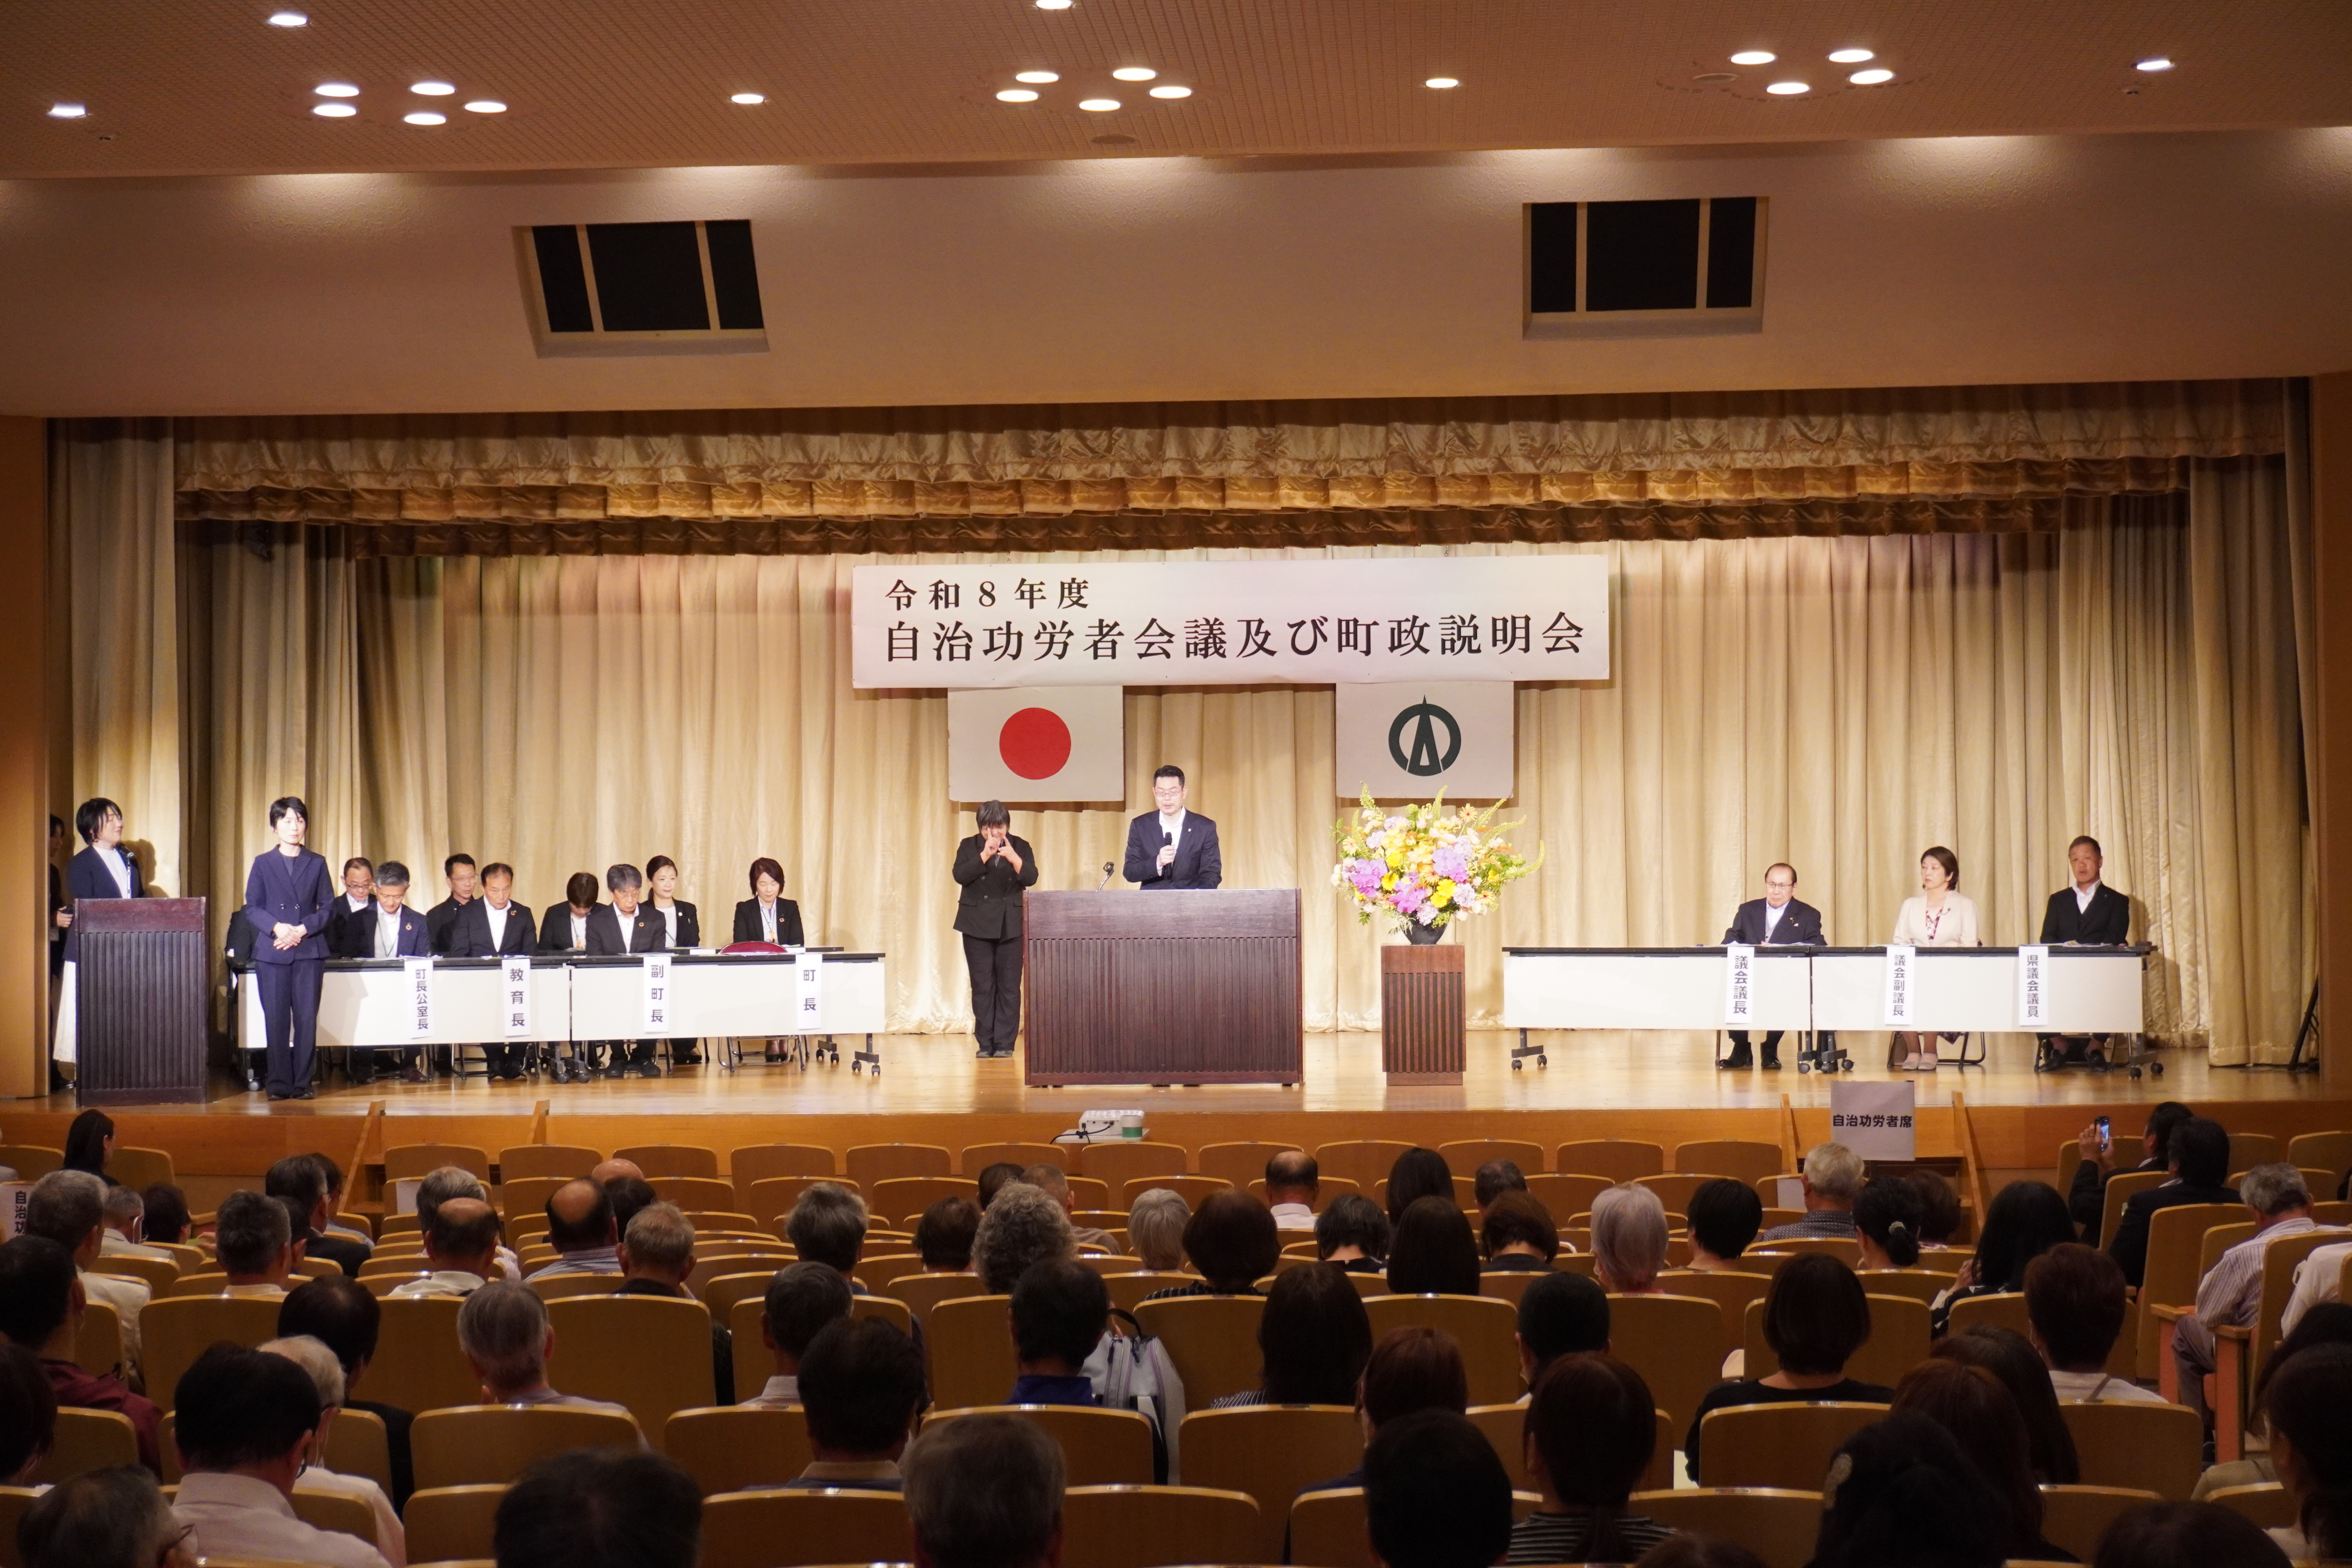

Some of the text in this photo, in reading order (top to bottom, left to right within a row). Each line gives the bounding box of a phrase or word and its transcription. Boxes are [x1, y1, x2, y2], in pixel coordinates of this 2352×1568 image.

[886, 578, 1088, 610] 令和8年度
[888, 612, 1584, 662] 自治功労者会議及び町政説明会
[416, 969, 428, 1029] 町長公室長
[510, 968, 525, 1027] 教育長
[651, 964, 664, 1022] 副町長
[803, 969, 816, 1011] 町長
[1733, 955, 1748, 1014] 議会議長
[1893, 955, 1906, 1016] 議会副議長
[2027, 955, 2039, 1017] 県議会議員
[1833, 1114, 1912, 1128] 自治功労者席
